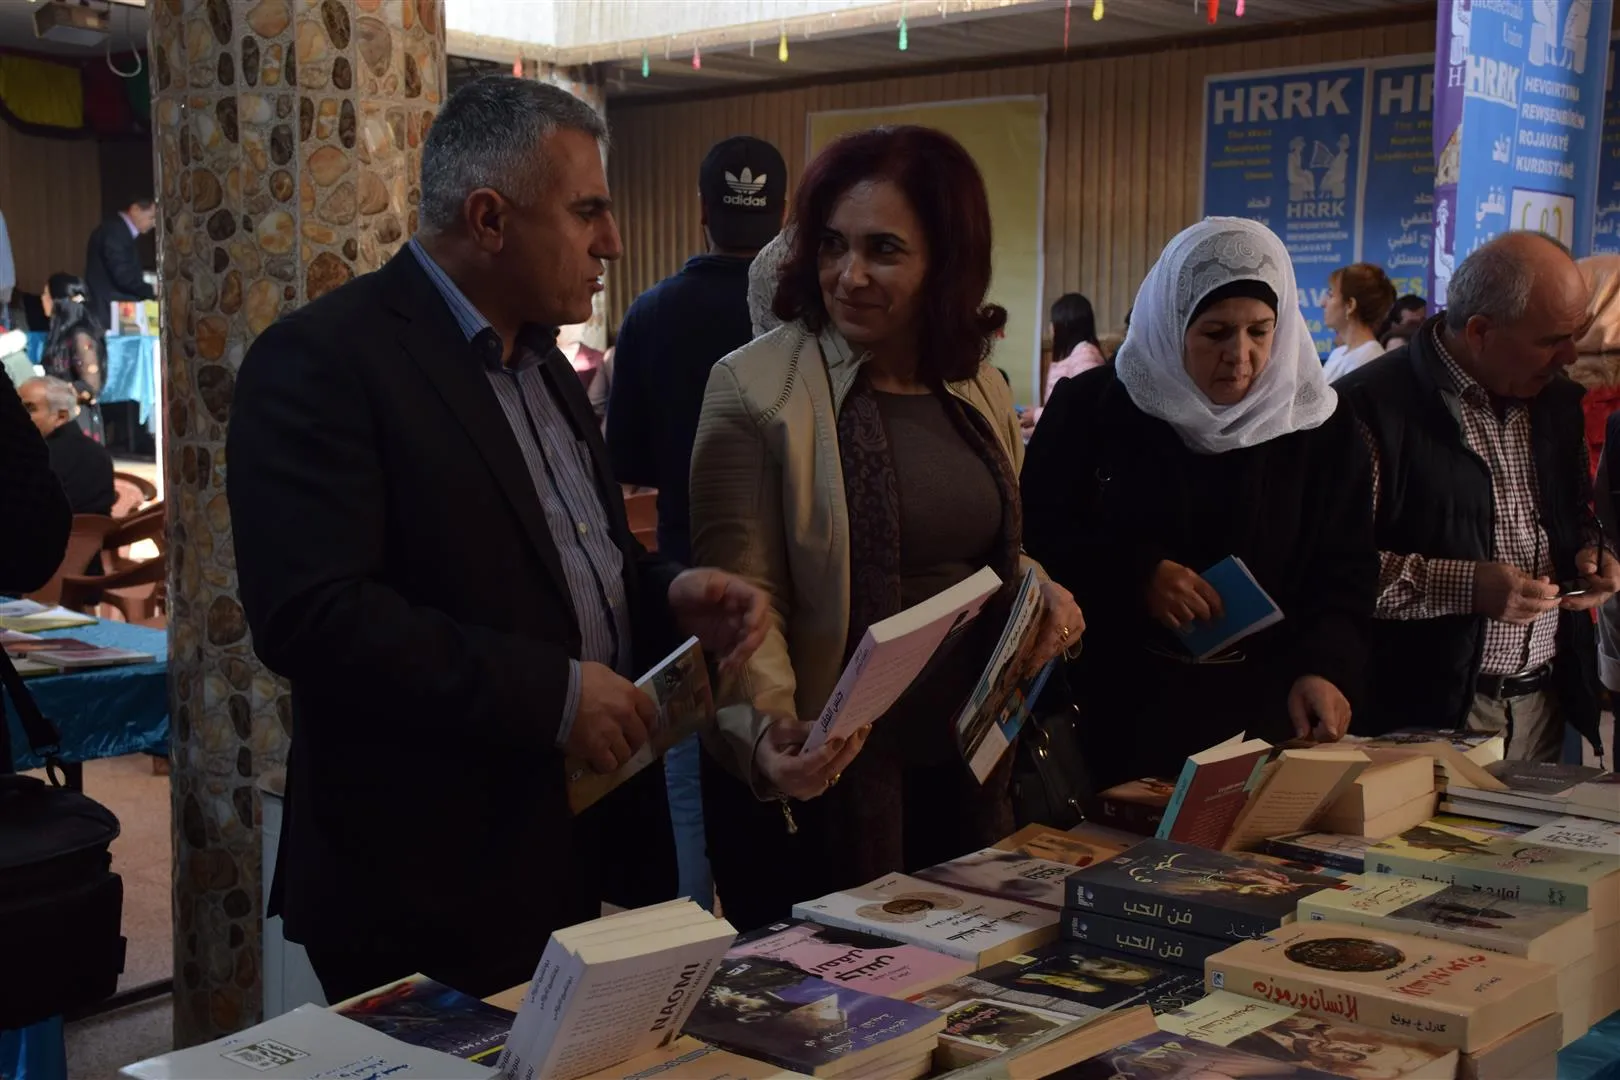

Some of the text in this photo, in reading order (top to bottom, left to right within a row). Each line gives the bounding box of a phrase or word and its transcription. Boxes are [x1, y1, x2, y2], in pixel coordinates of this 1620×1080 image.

[1465, 55, 1520, 105] HRRK
[1213, 77, 1352, 125] HRRK
[723, 195, 767, 207] adidas
[1287, 201, 1345, 218] HRRK
[1122, 899, 1193, 925] فن الحب
[1115, 931, 1184, 959] فن الحب
[649, 962, 701, 1033] NAOMI
